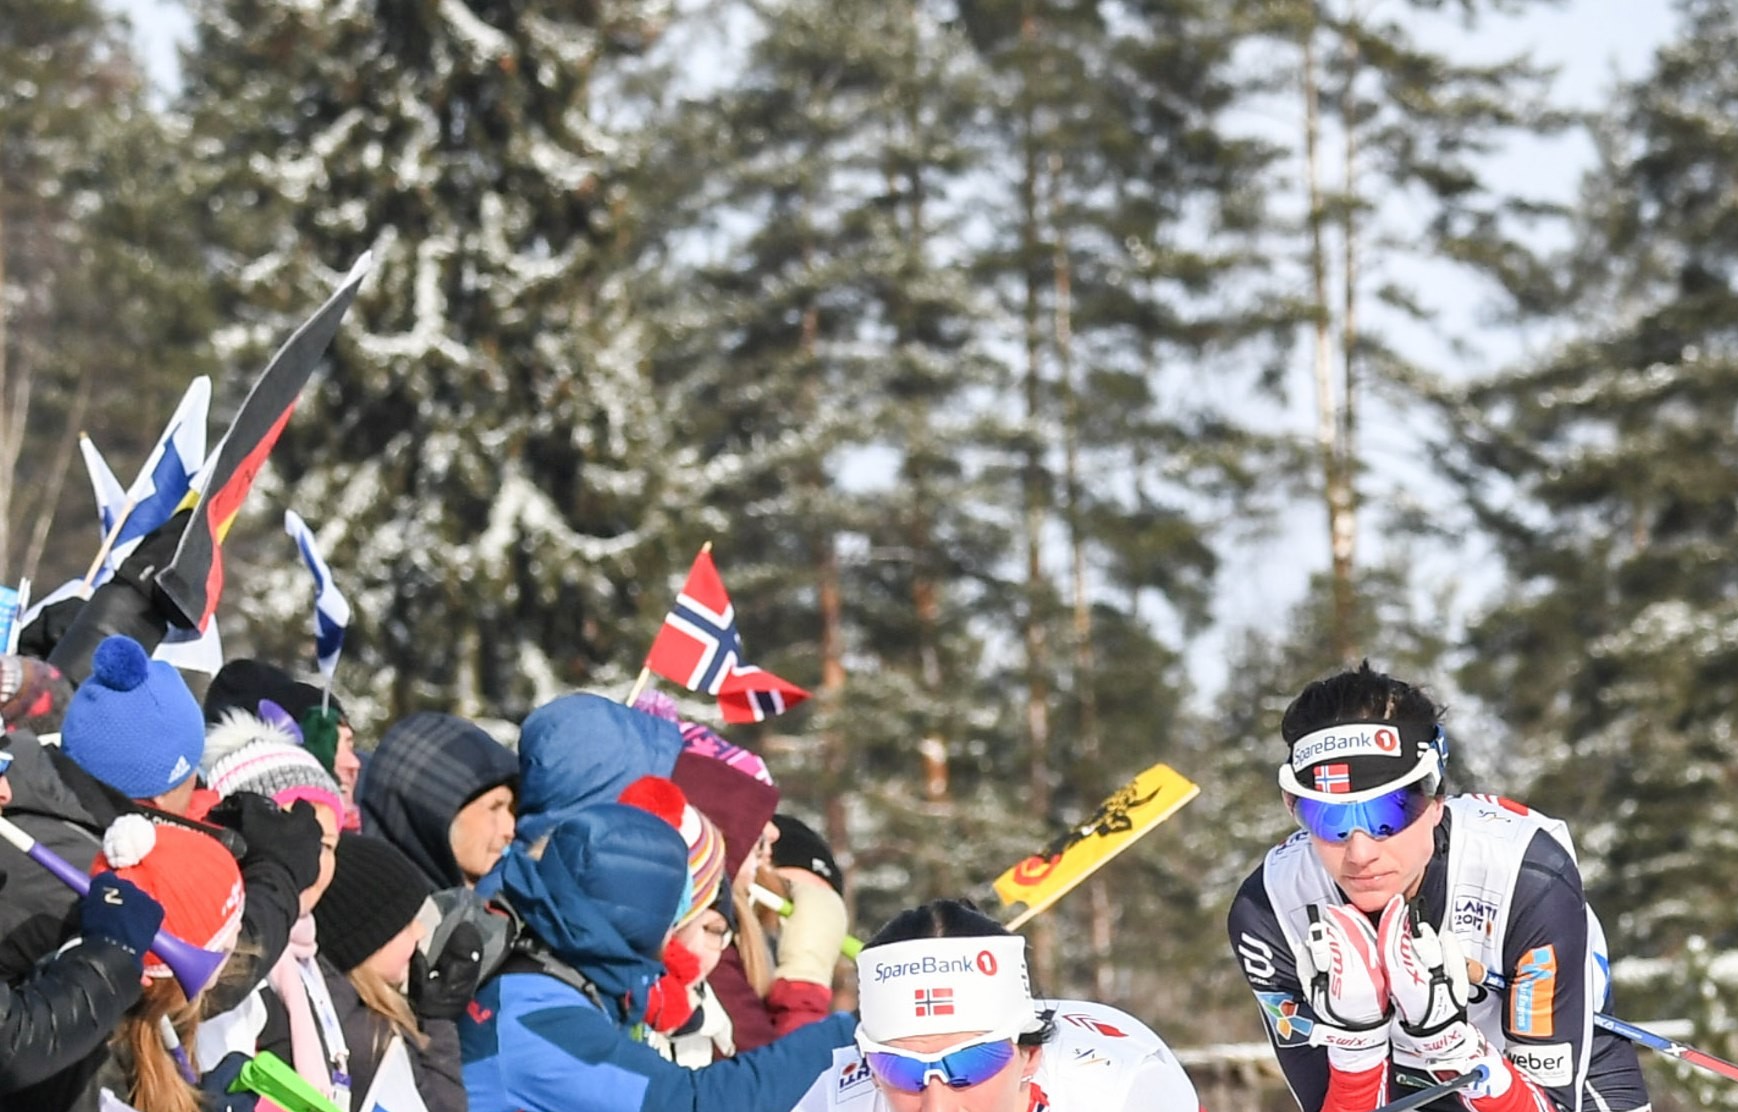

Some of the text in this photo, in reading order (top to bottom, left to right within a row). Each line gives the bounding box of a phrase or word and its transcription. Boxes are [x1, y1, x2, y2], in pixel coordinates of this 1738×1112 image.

[1294, 732, 1372, 766] SpareBank
[1455, 900, 1498, 920] LAHTI
[874, 955, 974, 983] SpareBank
